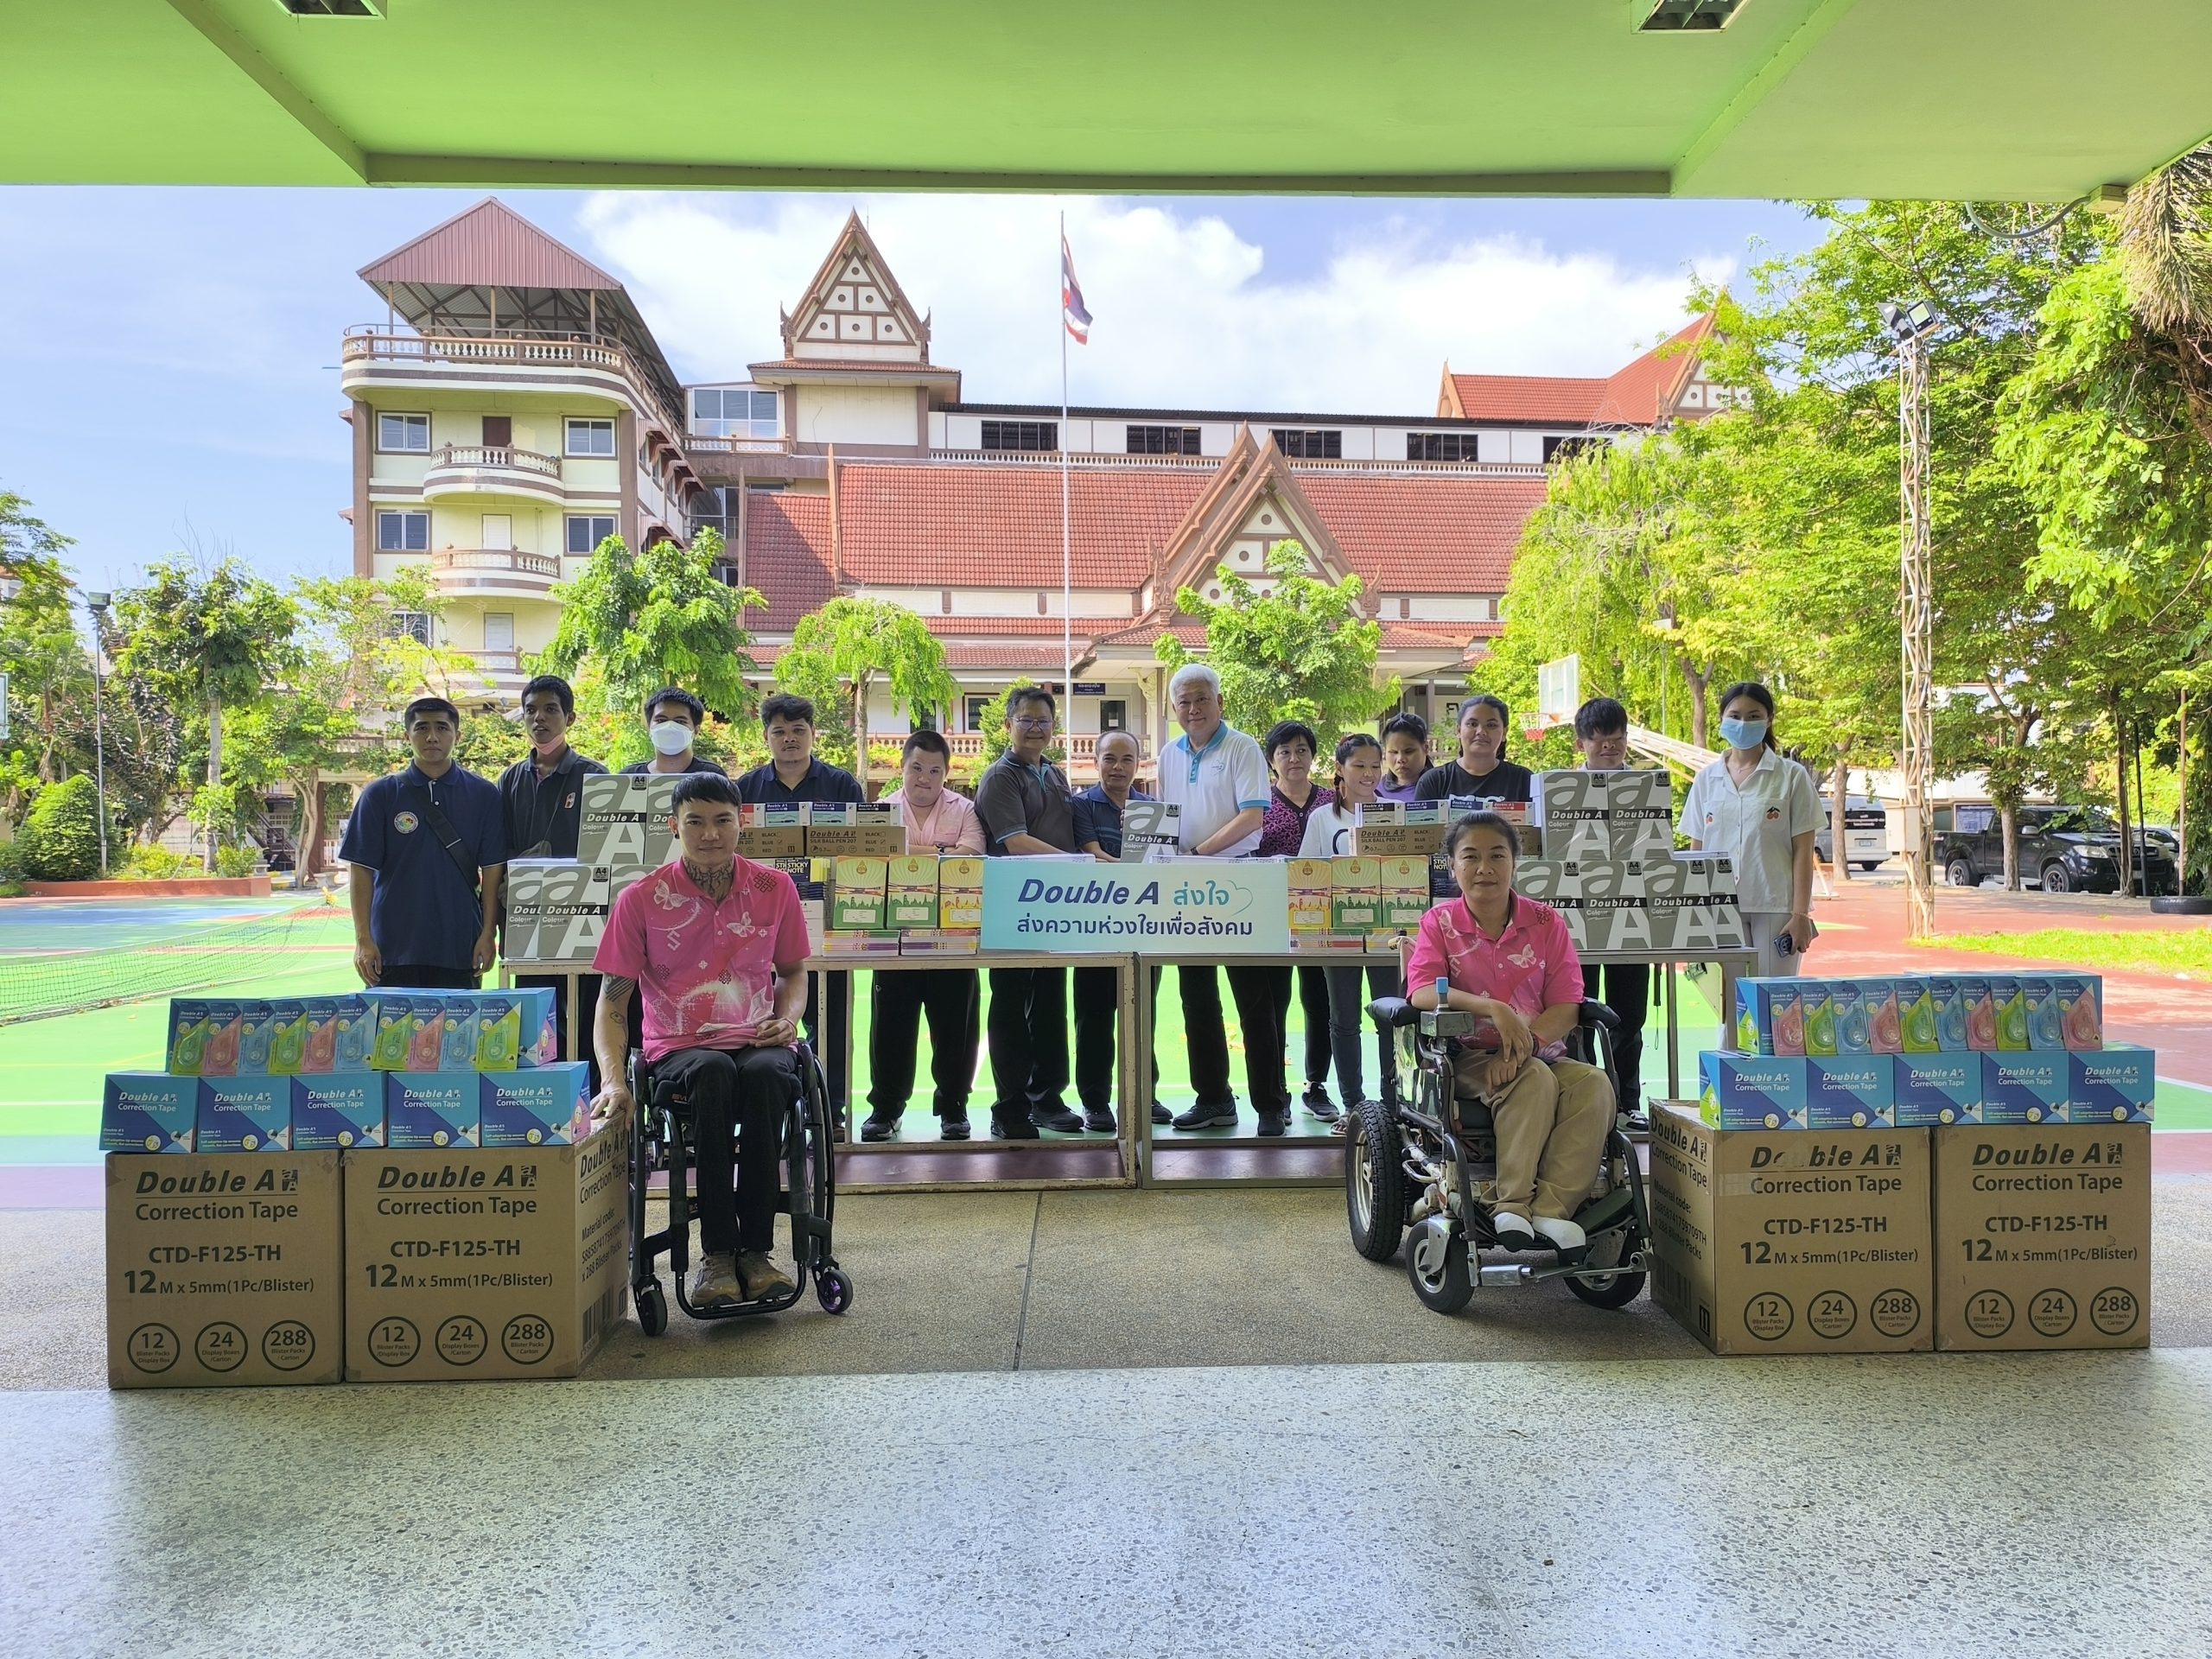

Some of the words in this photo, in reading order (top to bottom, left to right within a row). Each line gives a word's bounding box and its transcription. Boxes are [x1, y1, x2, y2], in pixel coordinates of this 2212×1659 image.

[1552, 810, 1591, 819] Double
[1128, 835, 1162, 843] Double
[1018, 879, 1129, 905] Double
[1135, 881, 1159, 906] A
[1173, 880, 1230, 906] ส่งใจ
[547, 906, 588, 914] Double
[593, 906, 601, 914] A
[1590, 899, 1630, 907] Double
[1018, 911, 1252, 936] ส่งความห่วงใยเพื่อสังคม
[1735, 1073, 1772, 1082] Double
[1774, 1073, 1782, 1082] A
[1823, 1072, 1859, 1081] Double
[1862, 1071, 1870, 1080] A
[1910, 1070, 1947, 1078] Double
[1998, 1067, 2034, 1076] Double
[2085, 1066, 2121, 1075] Double
[308, 1090, 346, 1099] Double
[347, 1089, 356, 1097] A
[404, 1089, 442, 1099] Double
[444, 1089, 453, 1097] A
[497, 1087, 534, 1097] Double
[537, 1087, 544, 1096] A
[1773, 1084, 1790, 1092] Tape
[119, 1092, 159, 1101] Double
[162, 1092, 171, 1103] A
[159, 1104, 176, 1113] Tape
[1651, 1115, 1688, 1151] Double
[1690, 1141, 1699, 1156] A
[581, 1140, 612, 1179] Double
[613, 1134, 620, 1153] A
[1751, 1145, 1853, 1168] Dble
[1859, 1144, 1880, 1165] A
[1972, 1142, 2074, 1166] Double
[2082, 1142, 2101, 1165] A
[1651, 1141, 1688, 1175] Correction
[1688, 1161, 1707, 1187] Tape
[136, 1170, 246, 1194] Double
[254, 1169, 275, 1192] A
[378, 1165, 486, 1189] Double
[493, 1165, 515, 1187] A
[581, 1173, 612, 1205] Correction
[612, 1161, 626, 1184] Tape
[1751, 1176, 1851, 1194] Correction
[1856, 1175, 1901, 1195] Tape
[1972, 1175, 2073, 1192] Correction
[2076, 1173, 2123, 1193] Tape
[136, 1204, 245, 1221] Correction
[248, 1202, 298, 1222] Tape
[378, 1198, 484, 1216] Correction
[487, 1197, 537, 1217] Tape
[1764, 1217, 1887, 1236] CTD-F125-TH
[1986, 1215, 2108, 1234] CTD-F125-TH
[149, 1244, 282, 1263] CTD-F125-TH
[391, 1239, 520, 1258] CTD-F125-TH
[1740, 1242, 1771, 1265] 12
[1775, 1252, 1787, 1265] M
[1790, 1255, 1799, 1264] x
[1802, 1249, 1918, 1265] 5mm(1Pc/Blister)
[1961, 1239, 1993, 1262] 12
[1996, 1249, 2008, 1262] M
[2012, 1253, 2020, 1262] x
[2022, 1246, 2138, 1262] 5mm(1Pc/Blister)
[124, 1270, 156, 1294] 12
[160, 1281, 173, 1294] M
[177, 1284, 185, 1294] x
[189, 1278, 315, 1294] 5mm(1Pc/Blister)
[365, 1264, 397, 1287] 12
[401, 1275, 415, 1287] M
[418, 1278, 427, 1287] x
[430, 1272, 553, 1289] 5mm(1Pc/Blister)
[1757, 1301, 1779, 1317] 12
[1820, 1300, 1844, 1315] 24
[1877, 1298, 1913, 1314] 288
[1977, 1299, 1999, 1315] 12
[2041, 1298, 2063, 1313] 24
[2097, 1296, 2131, 1312] 288
[141, 1332, 164, 1348] 12
[209, 1331, 233, 1347] 24
[270, 1330, 307, 1346] 288
[382, 1326, 404, 1343] 12
[449, 1325, 474, 1341] 24
[510, 1324, 546, 1340] 288
